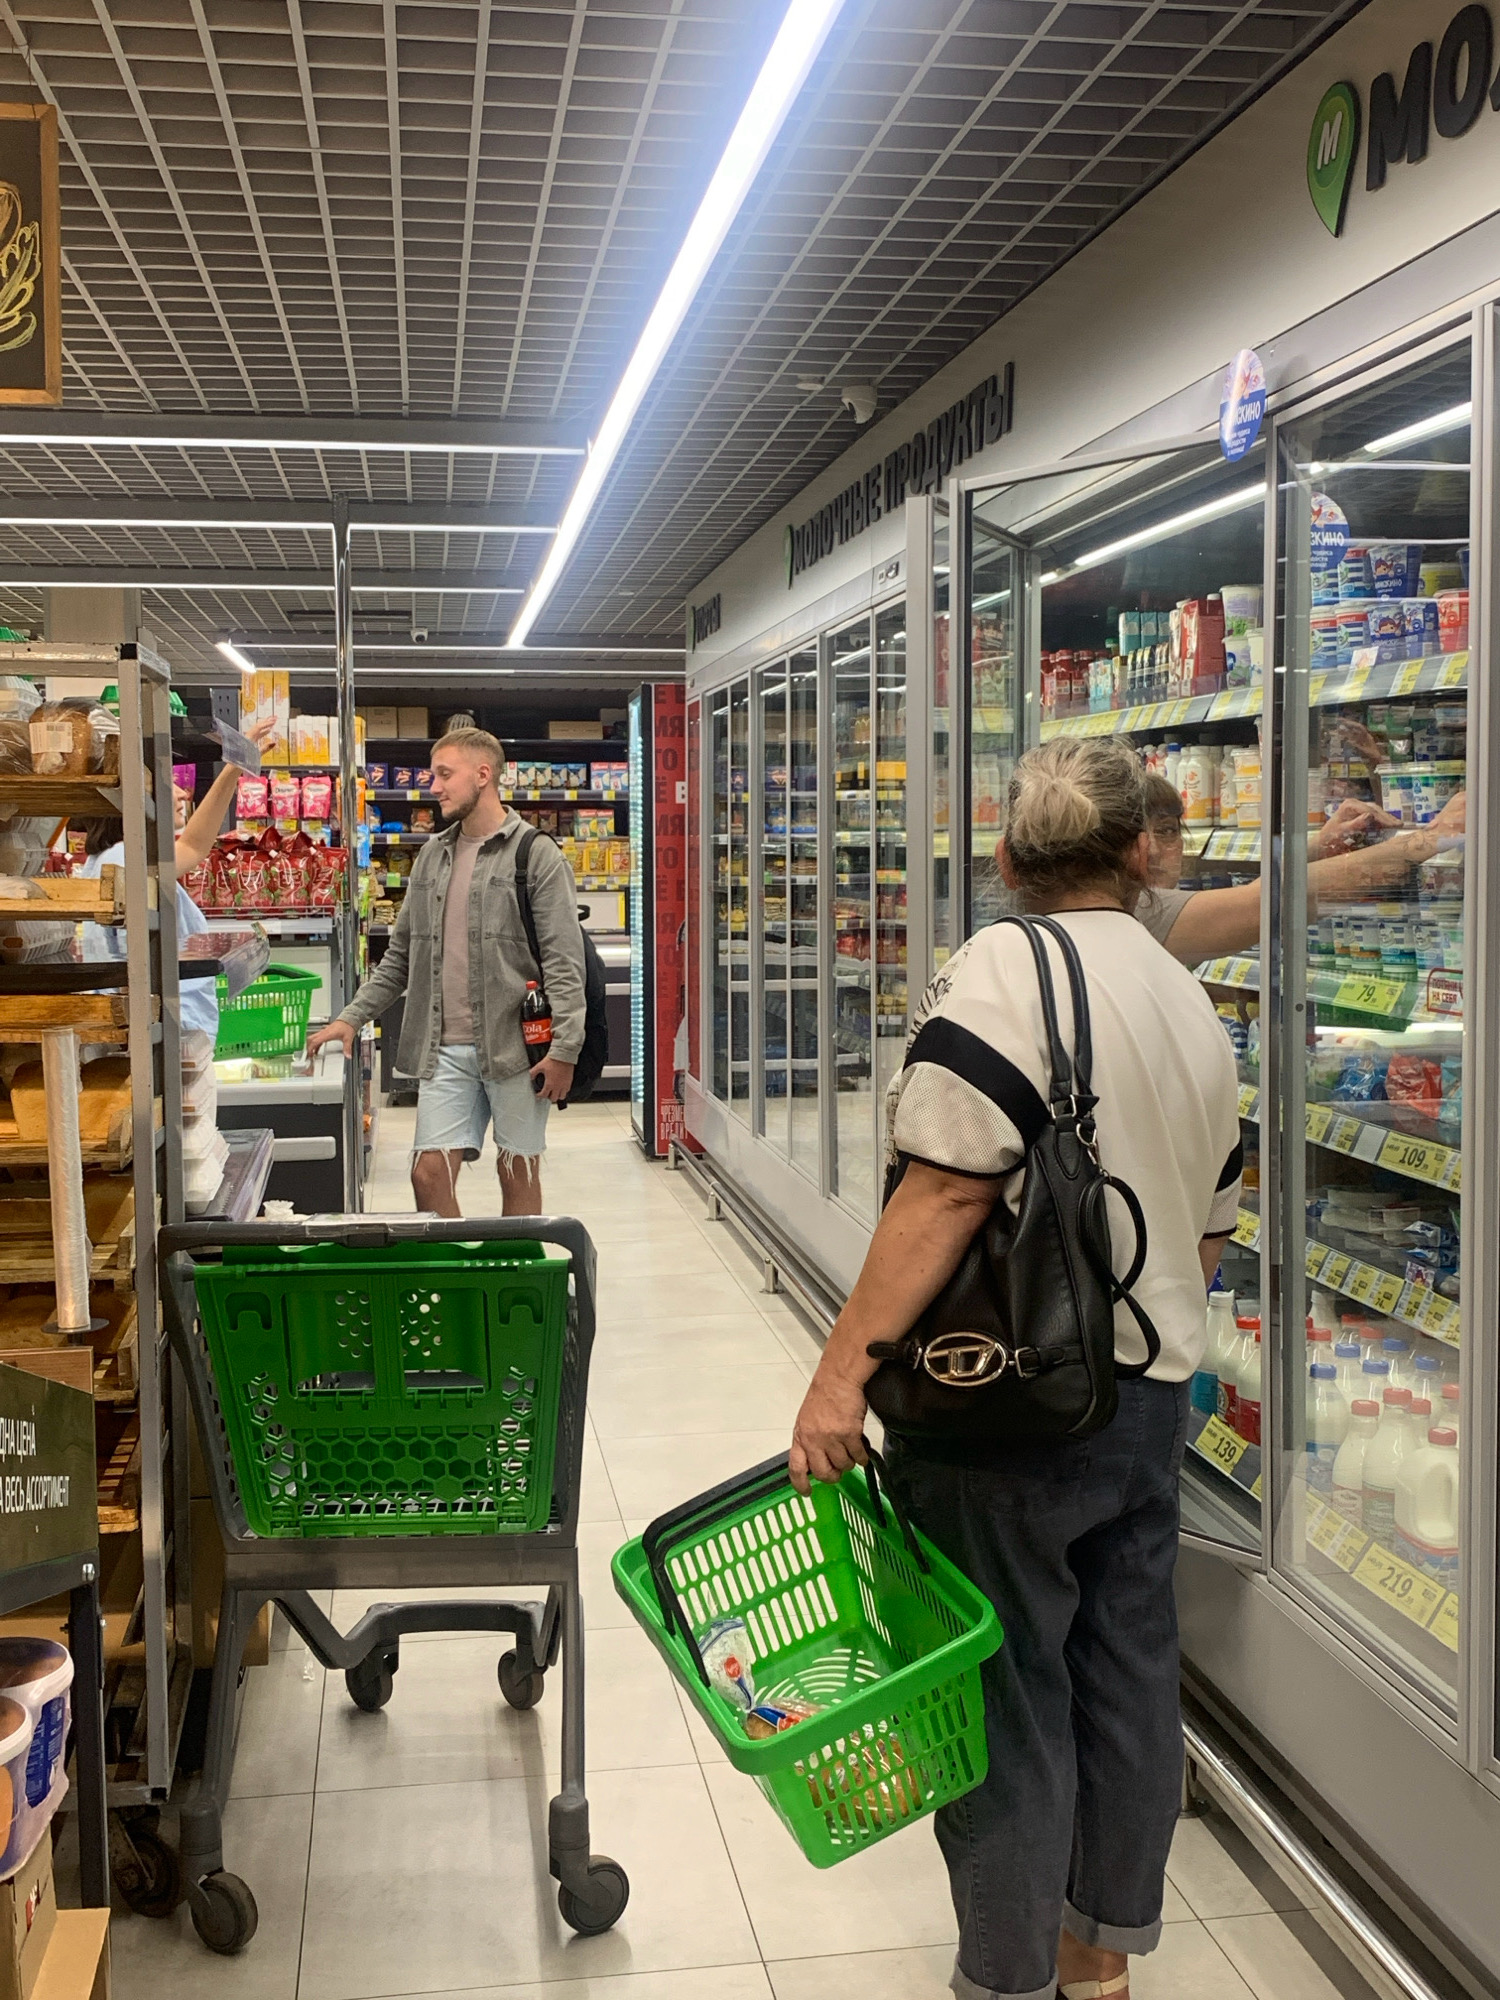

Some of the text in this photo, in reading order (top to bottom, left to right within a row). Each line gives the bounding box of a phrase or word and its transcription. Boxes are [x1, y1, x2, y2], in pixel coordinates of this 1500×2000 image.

[793, 362, 1014, 575] МОЛОЧНЫЕ ПРОДУКТЫ
[1357, 984, 1376, 1003] 79
[1432, 991, 1441, 1002] НА
[1399, 1147, 1426, 1168] 109
[0, 1417, 36, 1464] ДНА ЦЕНА
[1213, 1437, 1237, 1463] 139
[5, 1476, 25, 1514] ВЕСЬ
[26, 1476, 69, 1511] АССОРТИМЕНТ
[1379, 1566, 1413, 1598] 219
